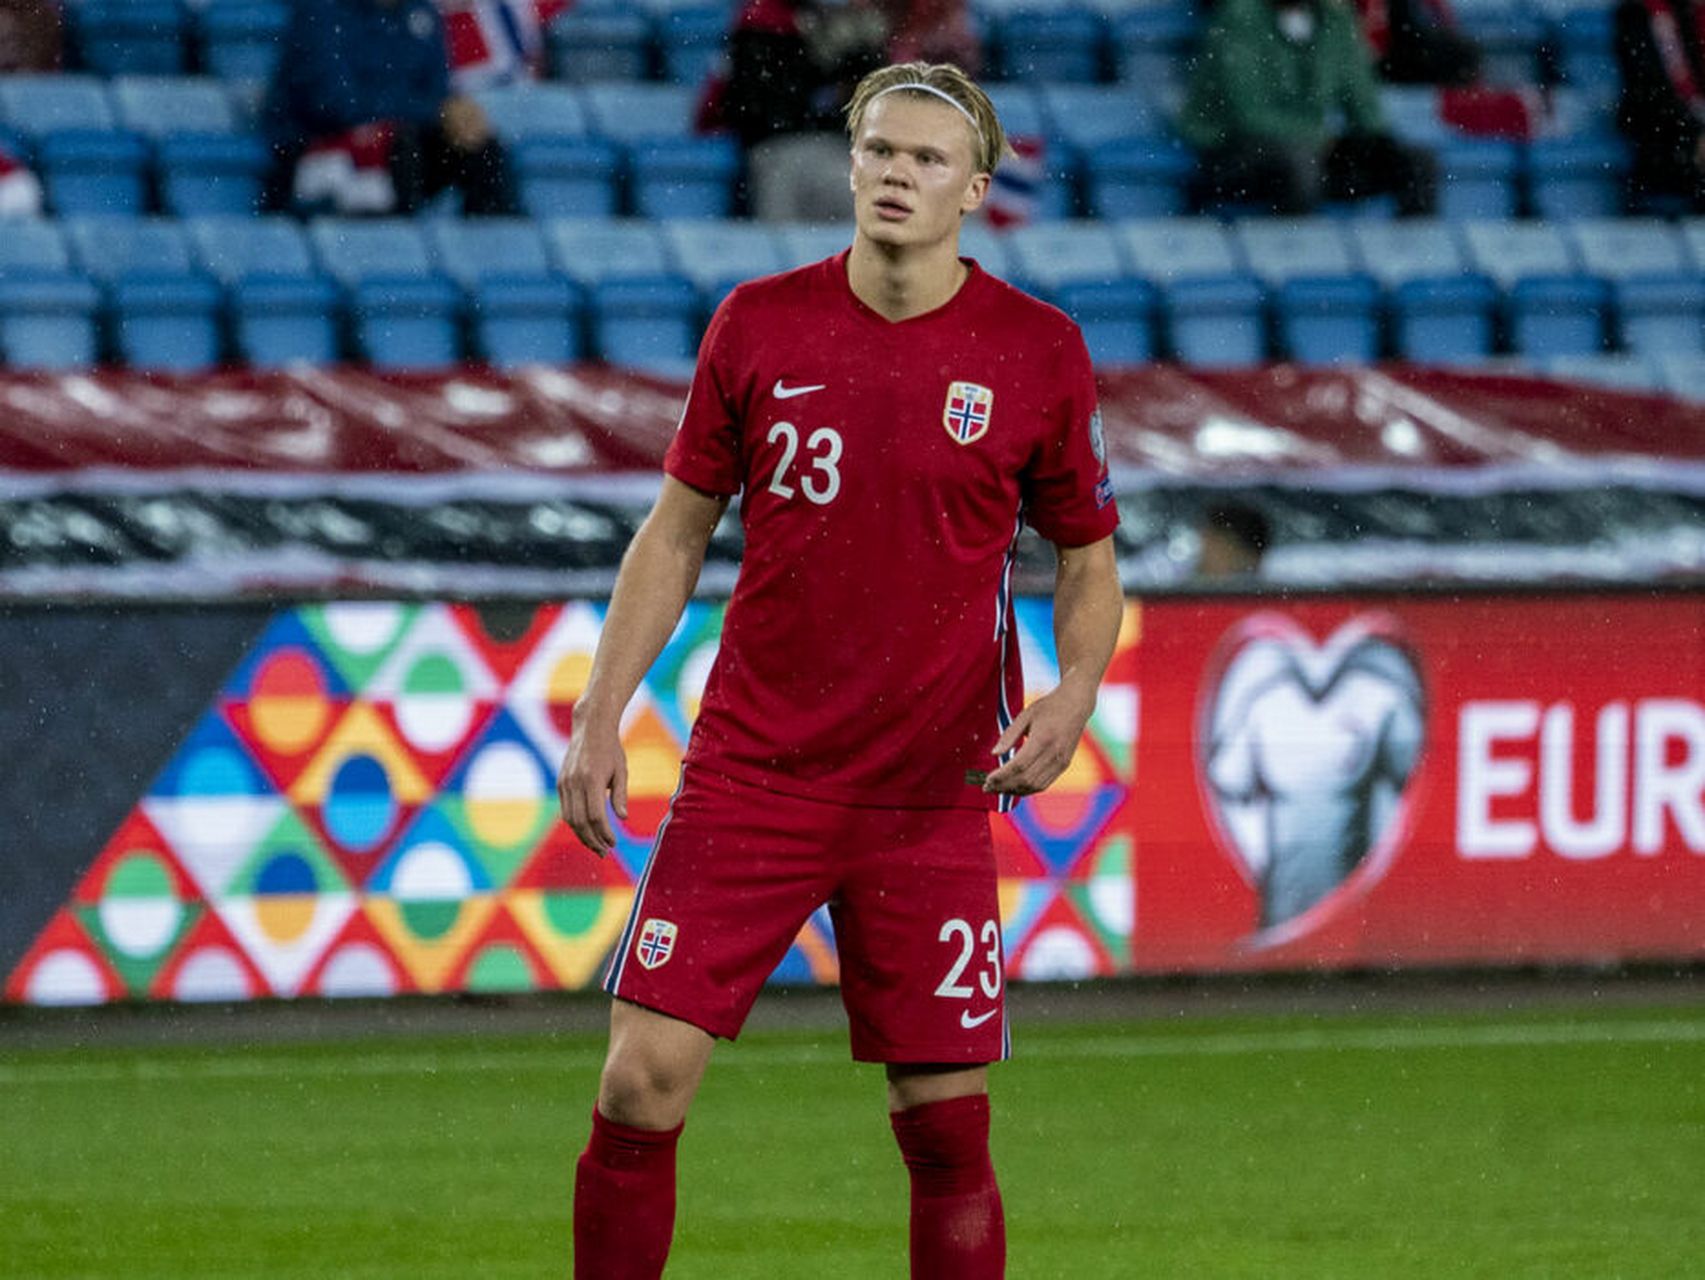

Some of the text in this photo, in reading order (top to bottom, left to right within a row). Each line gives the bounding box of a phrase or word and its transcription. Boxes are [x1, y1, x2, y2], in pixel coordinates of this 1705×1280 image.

[767, 421, 843, 505] 23
[1457, 700, 1705, 859] EUR
[934, 918, 1001, 999] 23
